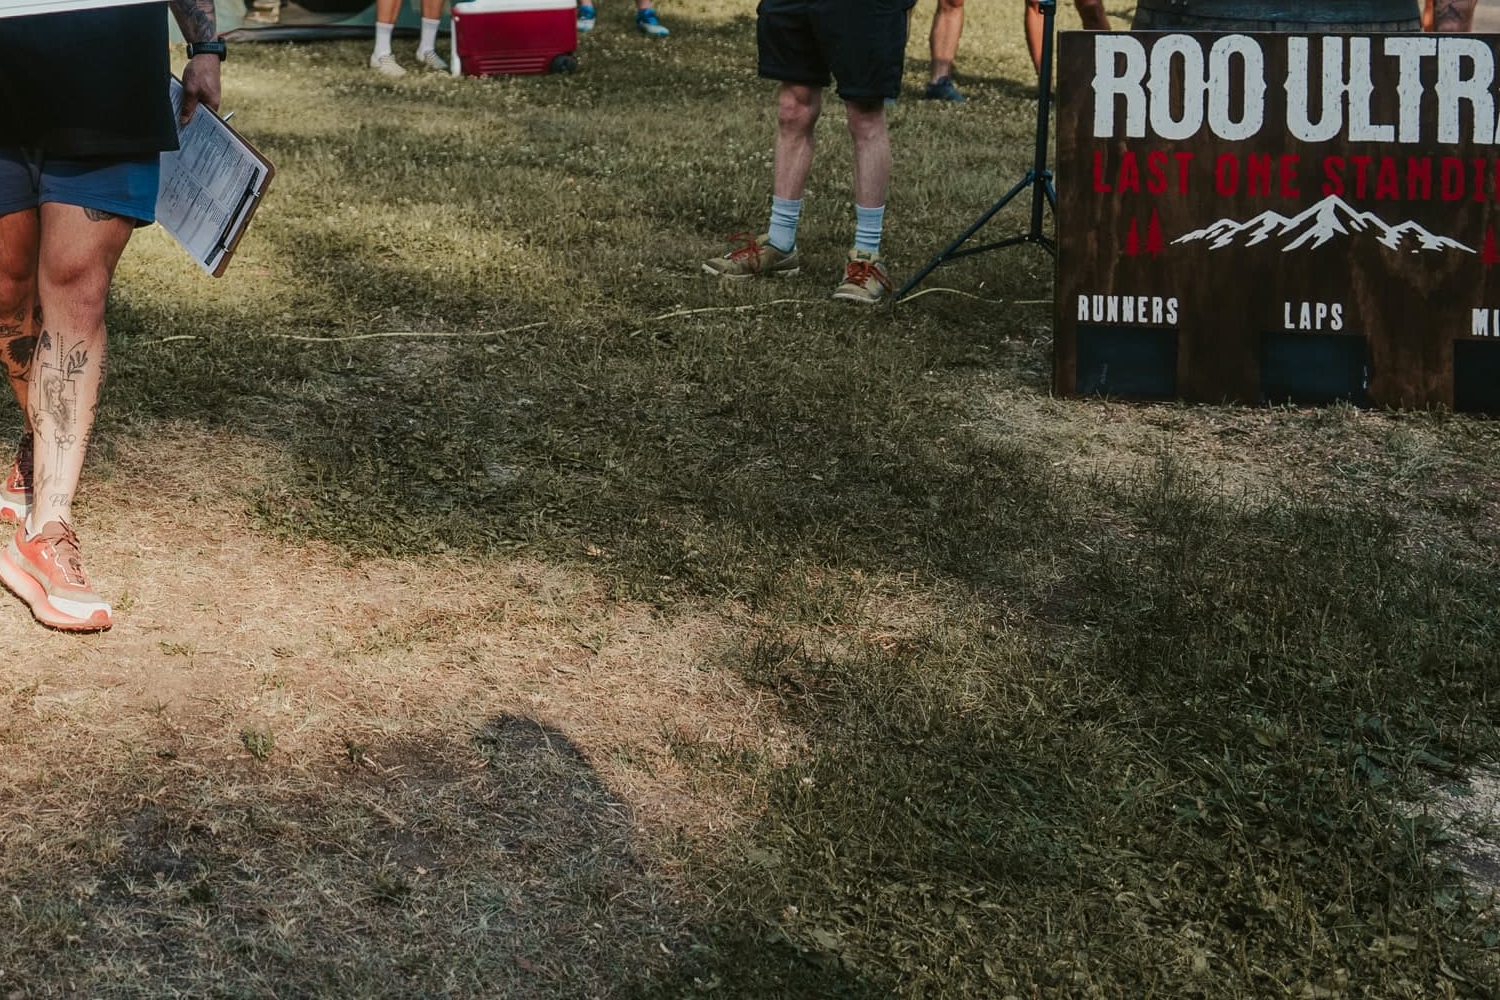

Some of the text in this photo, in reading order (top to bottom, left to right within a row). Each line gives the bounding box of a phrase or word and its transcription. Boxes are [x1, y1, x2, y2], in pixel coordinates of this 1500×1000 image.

[1091, 33, 1500, 144] ROO ULTR
[1092, 150, 1195, 196] LAST
[1215, 152, 1301, 198] ONE
[1077, 294, 1179, 325] RUNNERS
[1283, 302, 1344, 331] LAPS
